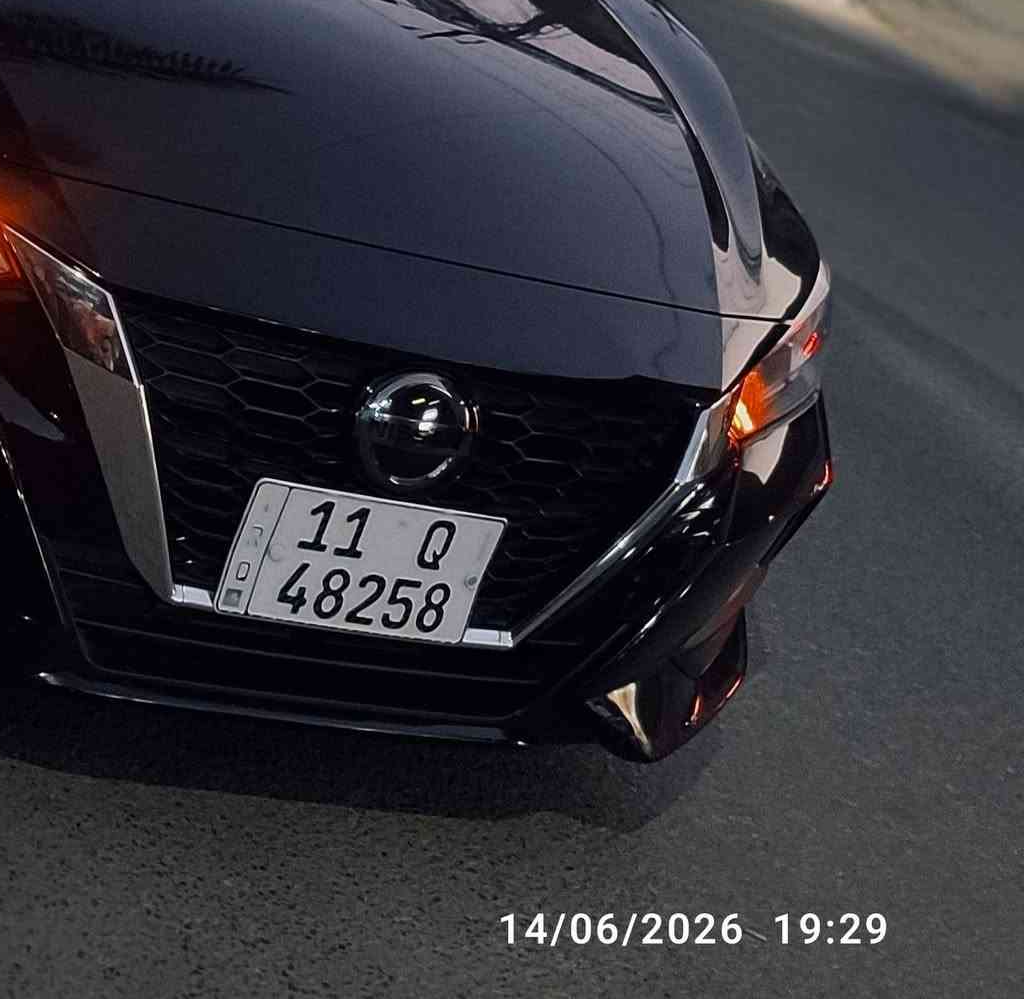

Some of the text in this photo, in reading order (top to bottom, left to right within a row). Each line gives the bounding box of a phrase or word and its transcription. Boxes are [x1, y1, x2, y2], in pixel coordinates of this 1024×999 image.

[297, 500, 371, 559] 11
[416, 520, 456, 570] Q
[277, 563, 451, 633] 48258
